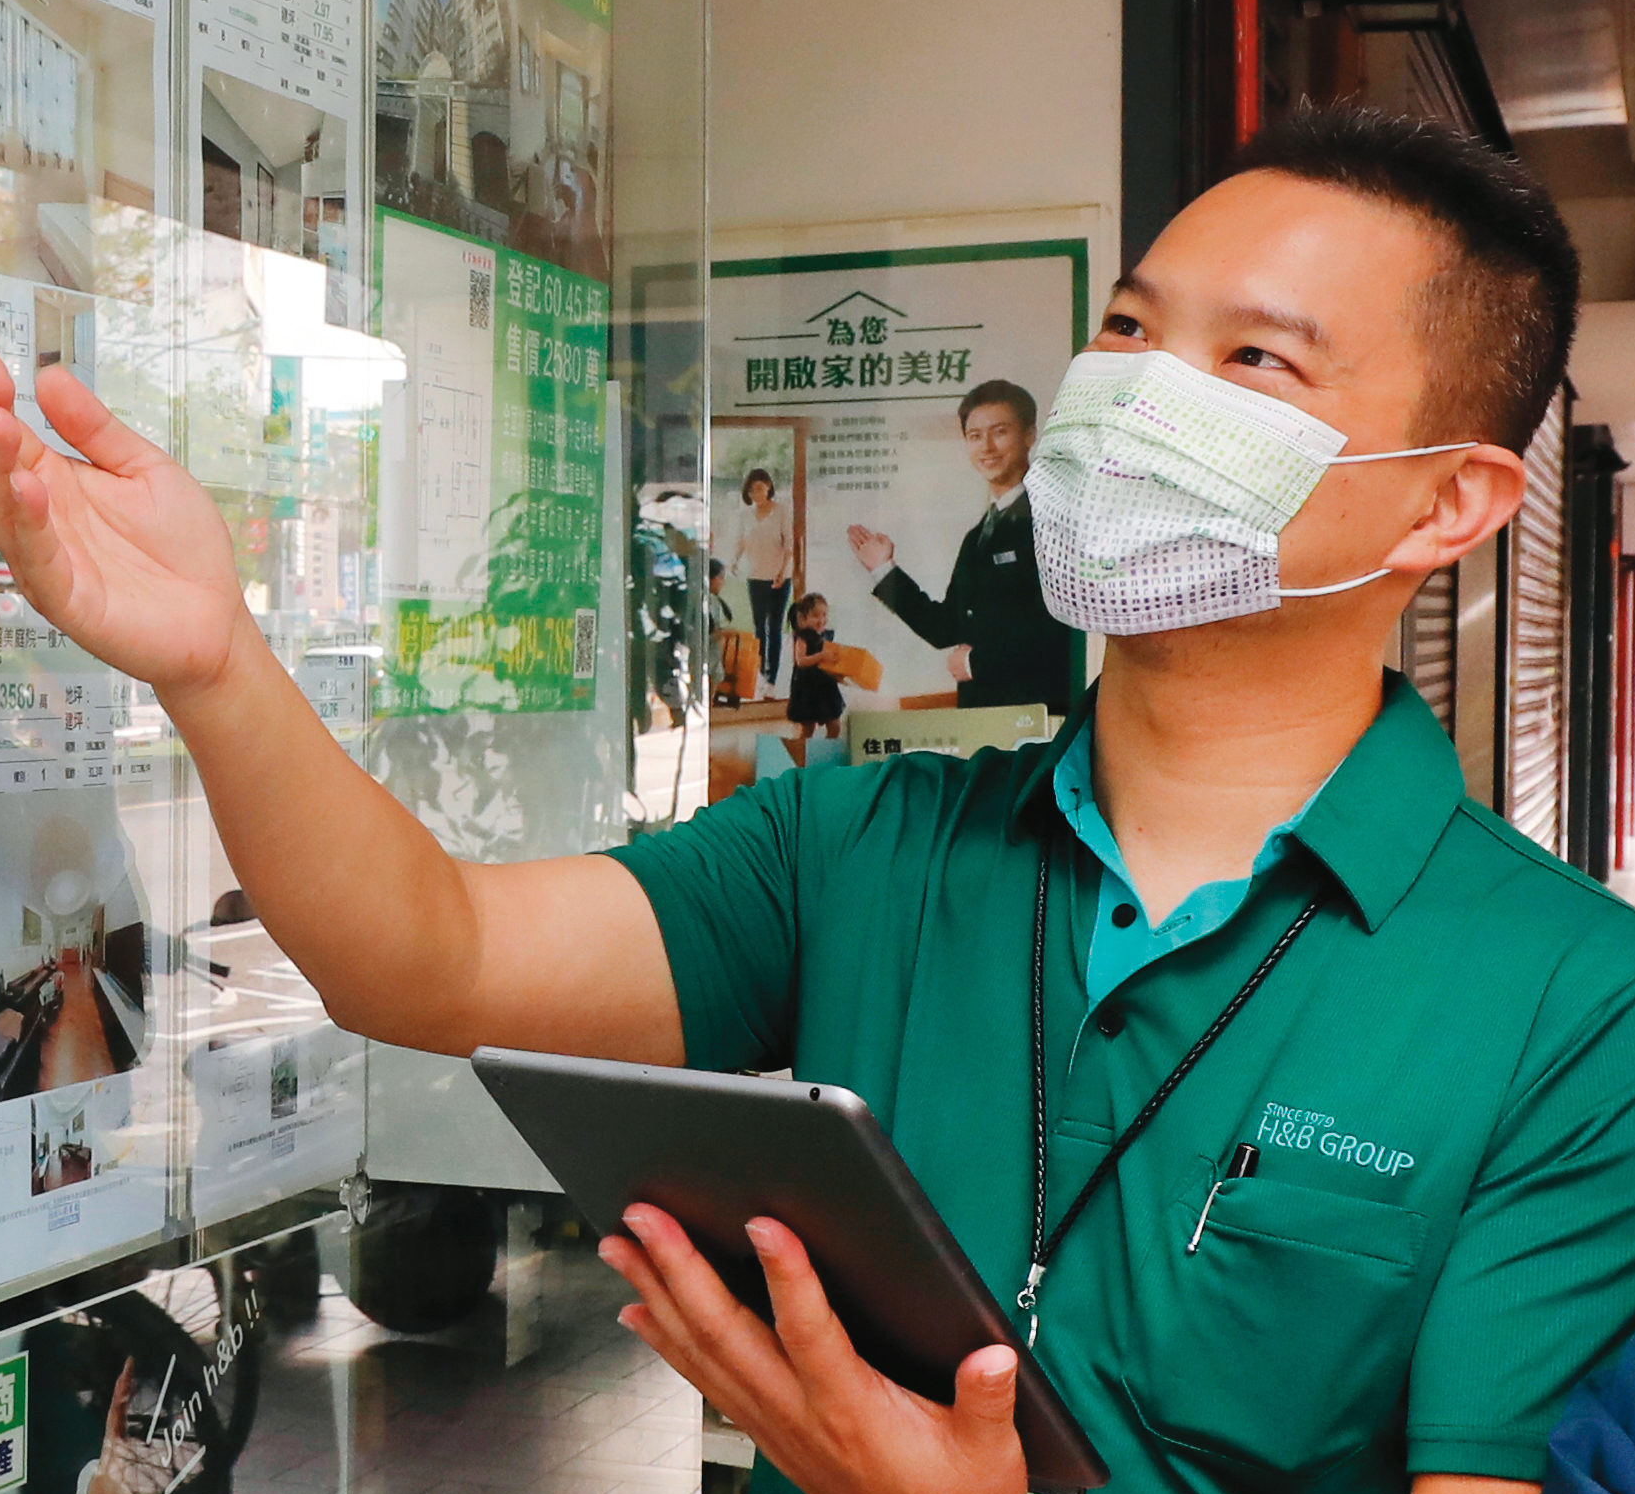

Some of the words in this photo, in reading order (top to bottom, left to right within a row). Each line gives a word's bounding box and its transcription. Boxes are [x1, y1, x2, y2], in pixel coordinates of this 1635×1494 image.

[543, 271, 583, 324] 60.45
[827, 316, 889, 346] 為您
[543, 337, 581, 384] 2580
[746, 348, 972, 393] 開啟家的美好
[863, 738, 902, 754] 住商
[1264, 1101, 1302, 1122] SINCE
[1304, 1110, 1335, 1128] 1979
[1257, 1115, 1315, 1150] H&B
[1319, 1131, 1415, 1177] GROUP
[160, 1385, 202, 1467] Join
